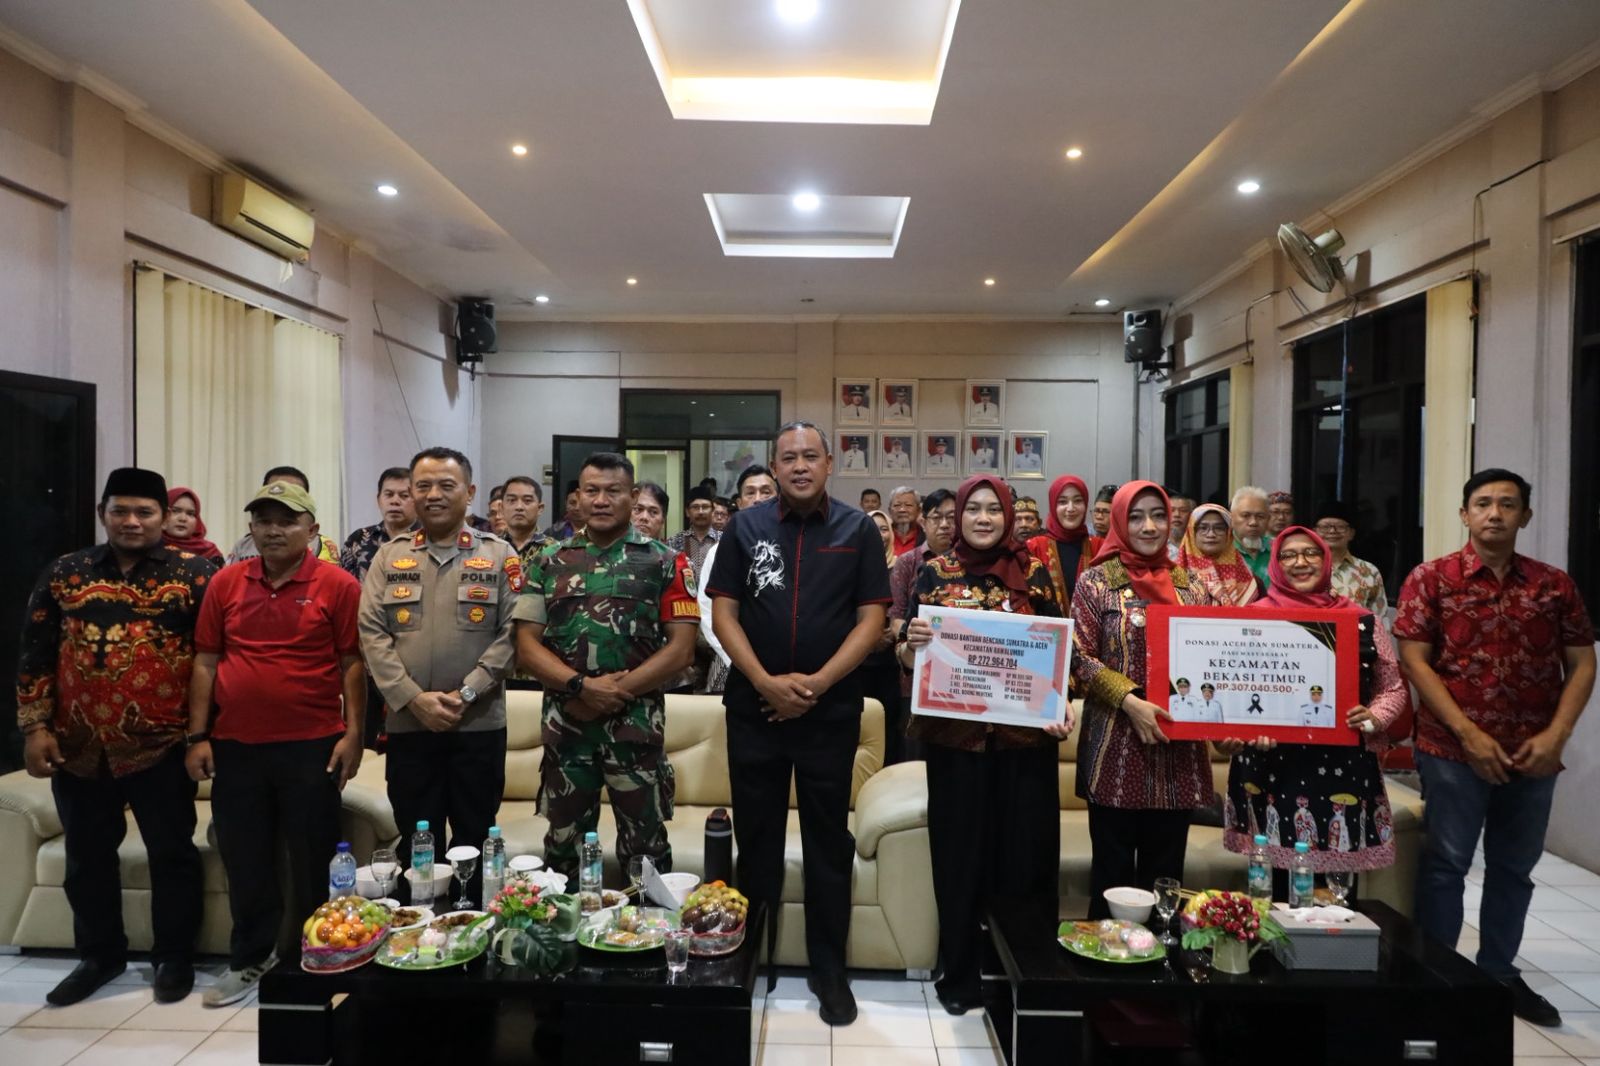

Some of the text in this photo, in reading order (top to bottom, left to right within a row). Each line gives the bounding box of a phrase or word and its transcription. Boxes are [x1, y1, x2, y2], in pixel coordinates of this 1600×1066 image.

[387, 573, 420, 581] AKHMADI
[461, 573, 497, 583] POLRI
[940, 632, 959, 641] DONASI
[959, 634, 982, 643] BANTUAN
[982, 636, 1005, 645] BENCANA
[1005, 638, 1029, 649] SUMATRA
[963, 644, 1025, 657] KECAMATAN RAWALUMBU
[1209, 658, 1301, 670] KECAMATAN
[1203, 672, 1307, 684] BEKASI TIMUR
